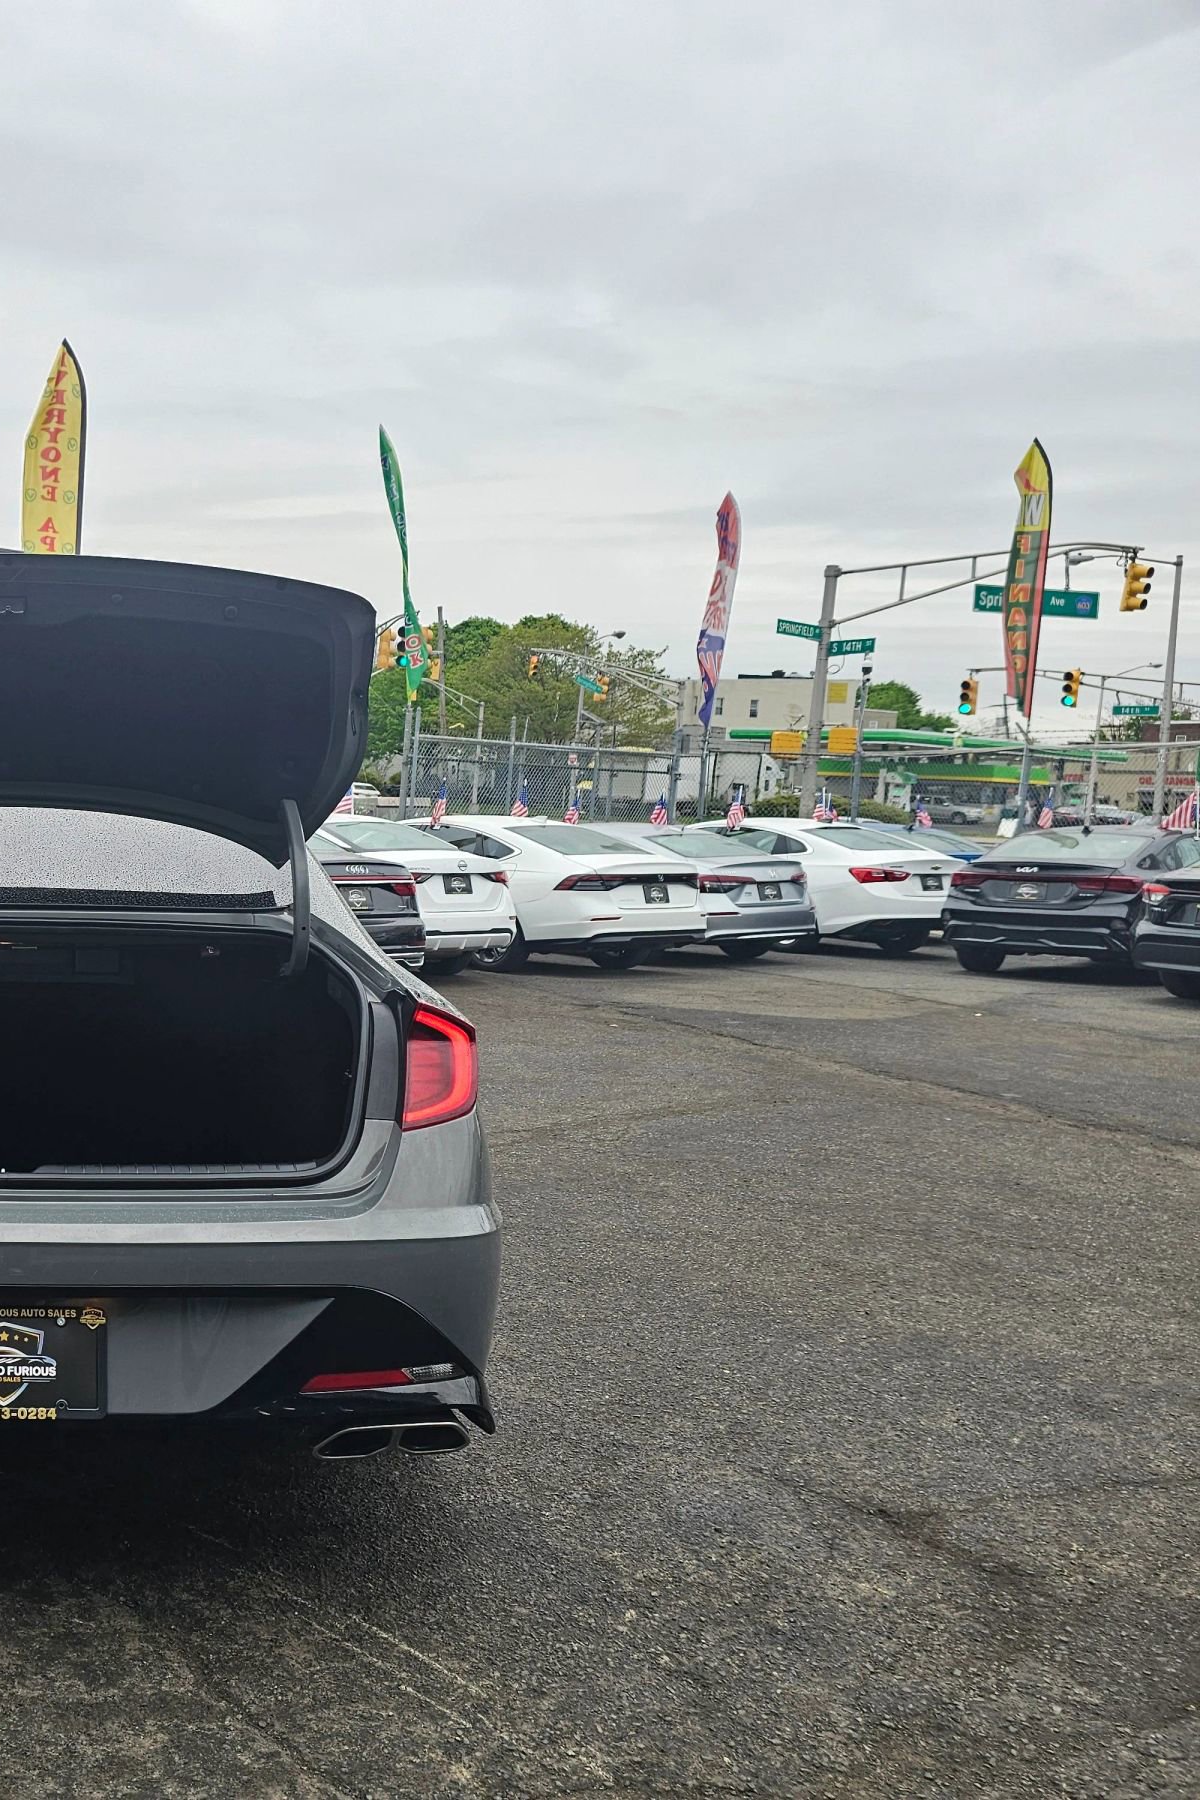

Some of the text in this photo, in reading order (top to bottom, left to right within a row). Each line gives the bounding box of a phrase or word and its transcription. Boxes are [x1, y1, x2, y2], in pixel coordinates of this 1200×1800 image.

[979, 591, 1003, 608] Spri
[1050, 596, 1065, 606] Ave
[778, 621, 814, 637] SPRINGFIELD
[832, 644, 838, 653] S
[842, 641, 862, 652] 14TH
[20, 1308, 46, 1318] AUTO
[47, 1308, 77, 1318] SALES
[7, 1365, 57, 1377] FURIOUS
